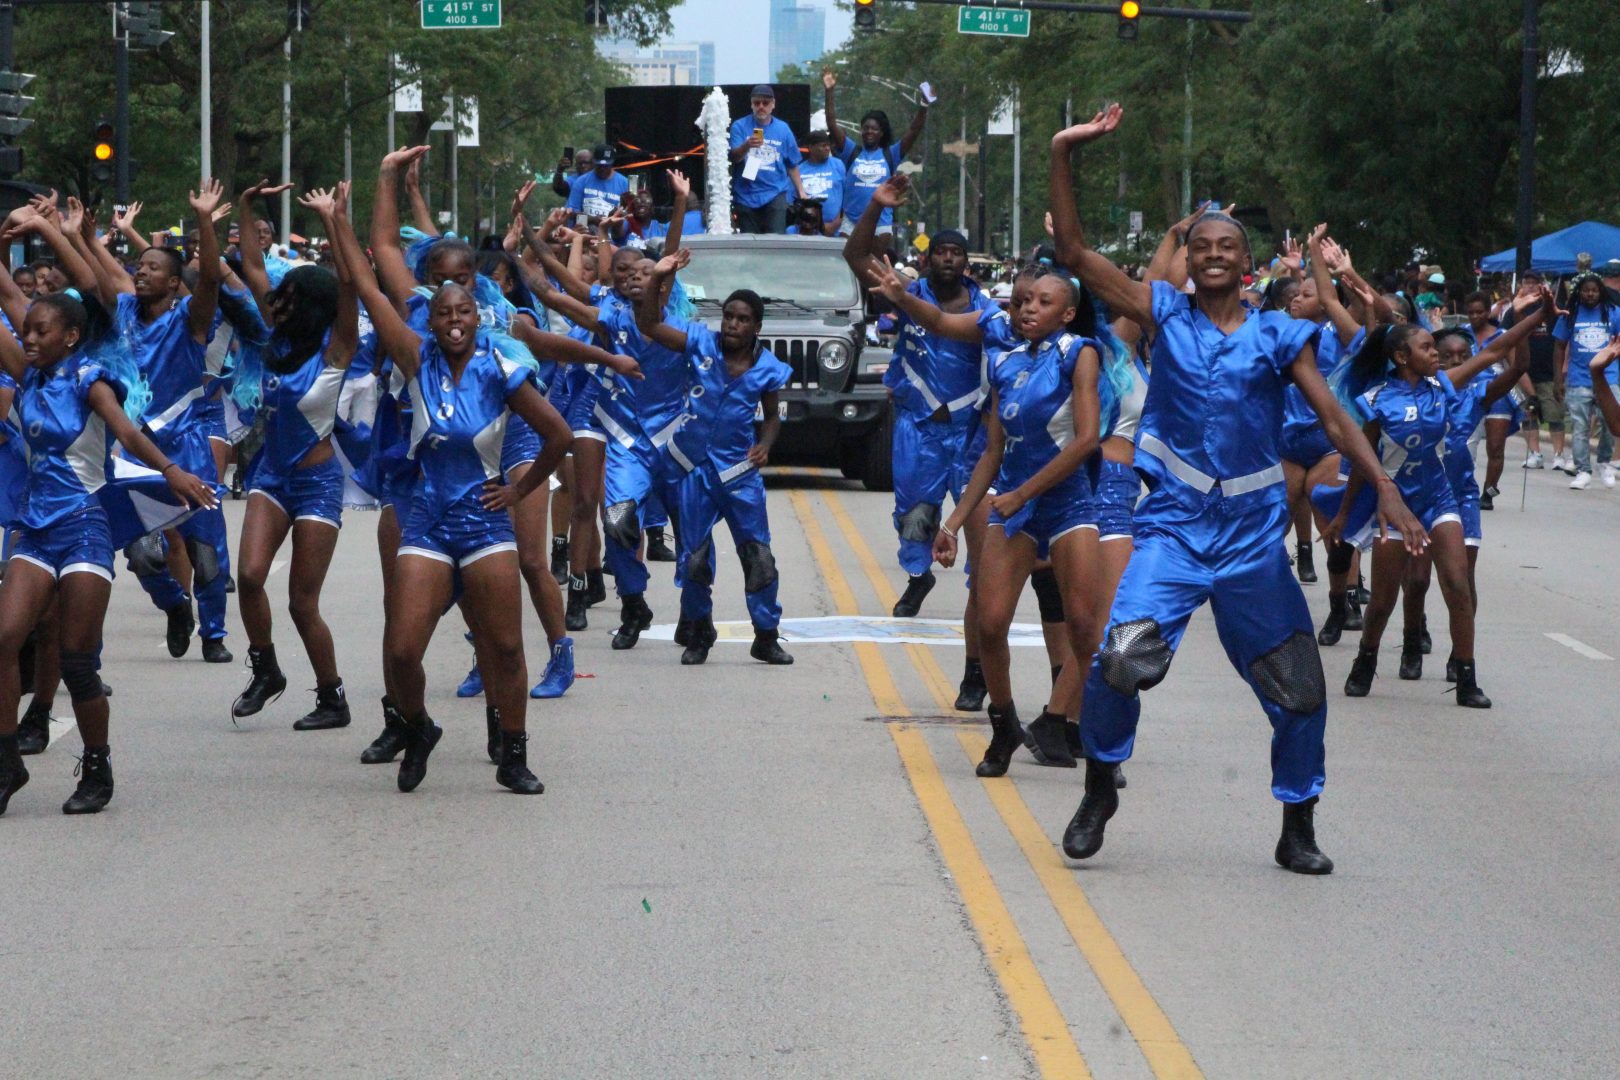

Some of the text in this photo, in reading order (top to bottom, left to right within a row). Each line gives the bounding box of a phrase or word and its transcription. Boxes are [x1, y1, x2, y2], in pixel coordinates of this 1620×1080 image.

[428, 4, 434, 13] E
[481, 4, 494, 12] ST
[445, 15, 478, 24] 4100 S
[965, 11, 971, 19] E
[1013, 14, 1024, 22] ST
[979, 23, 1009, 32] 4100 S
[1403, 405, 1423, 476] BOT
